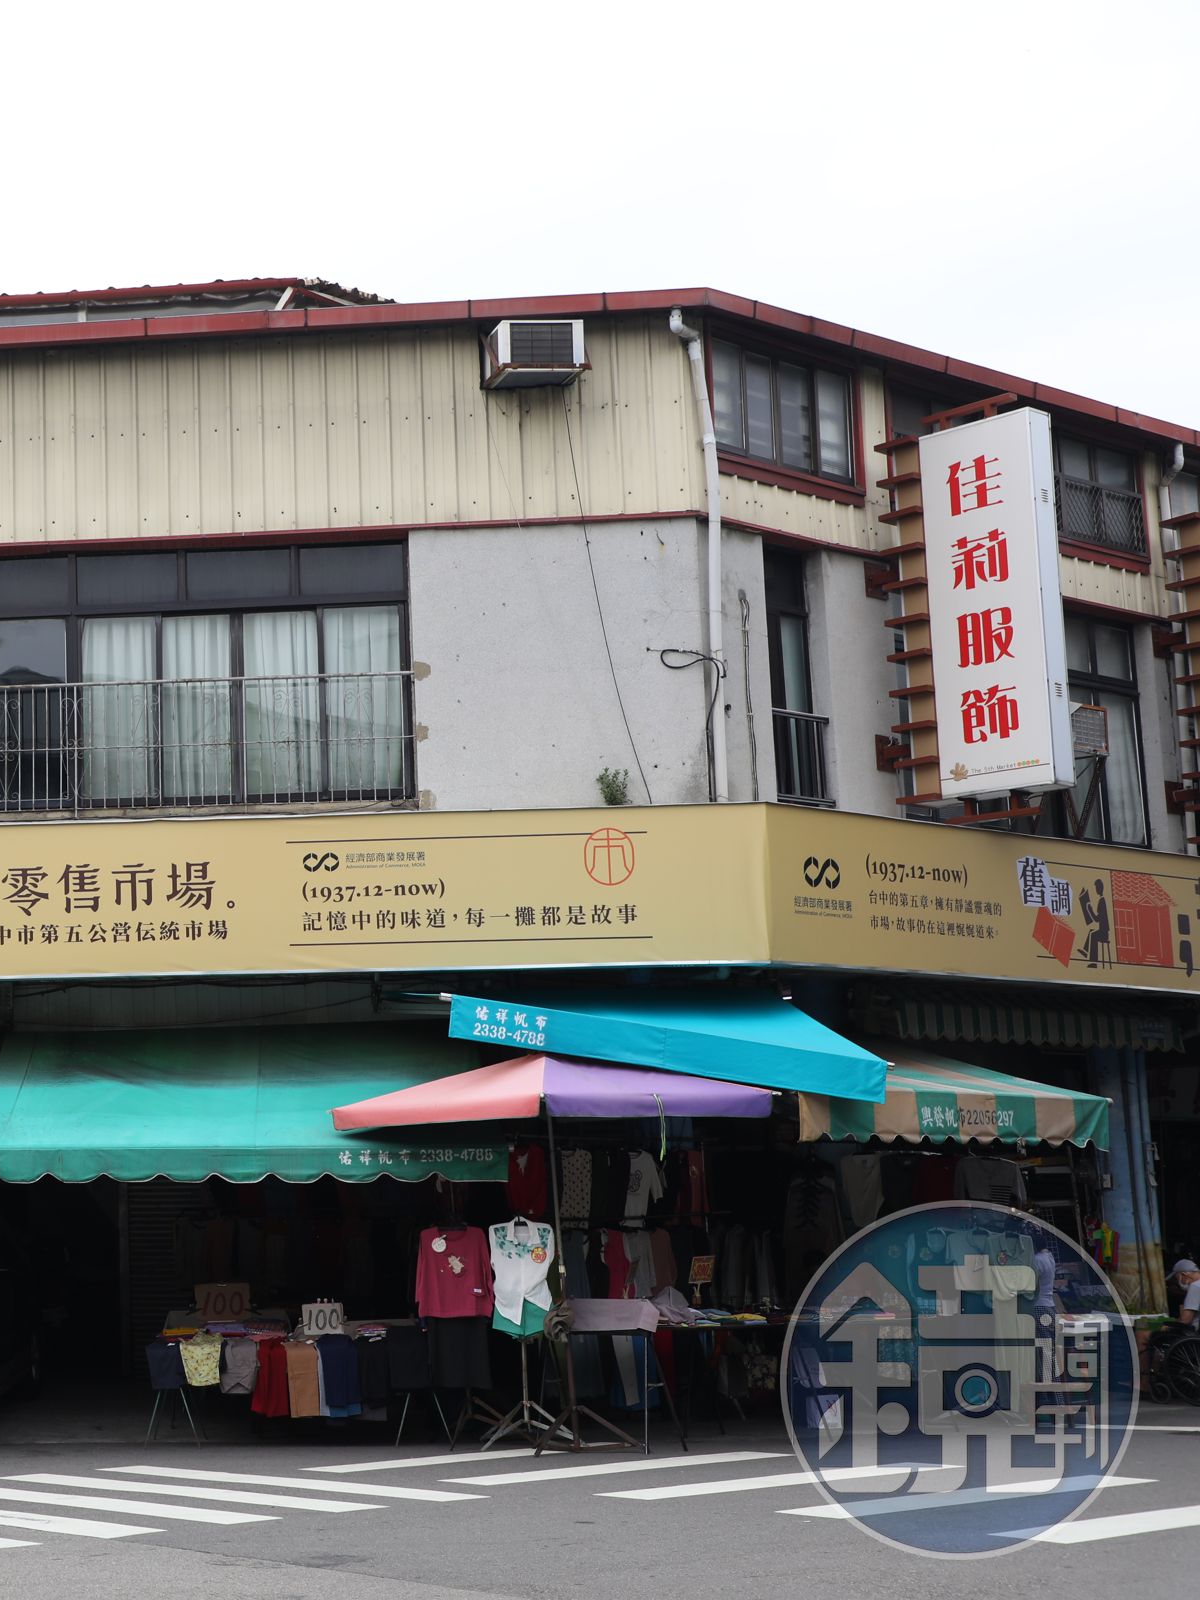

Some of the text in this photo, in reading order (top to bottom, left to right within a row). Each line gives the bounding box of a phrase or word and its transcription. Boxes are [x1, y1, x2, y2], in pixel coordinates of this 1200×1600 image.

[945, 454, 1020, 745] 佳莉服飾
[865, 851, 969, 889] (1937.12-now)
[302, 878, 446, 904] (1937.12-now)
[302, 903, 638, 932] 記憶中的味道，每一攤都是故事
[473, 1022, 546, 1047] 2338-4788
[419, 1147, 494, 1163] 2338-4788
[202, 1291, 245, 1316] 100
[308, 1308, 341, 1331] 100
